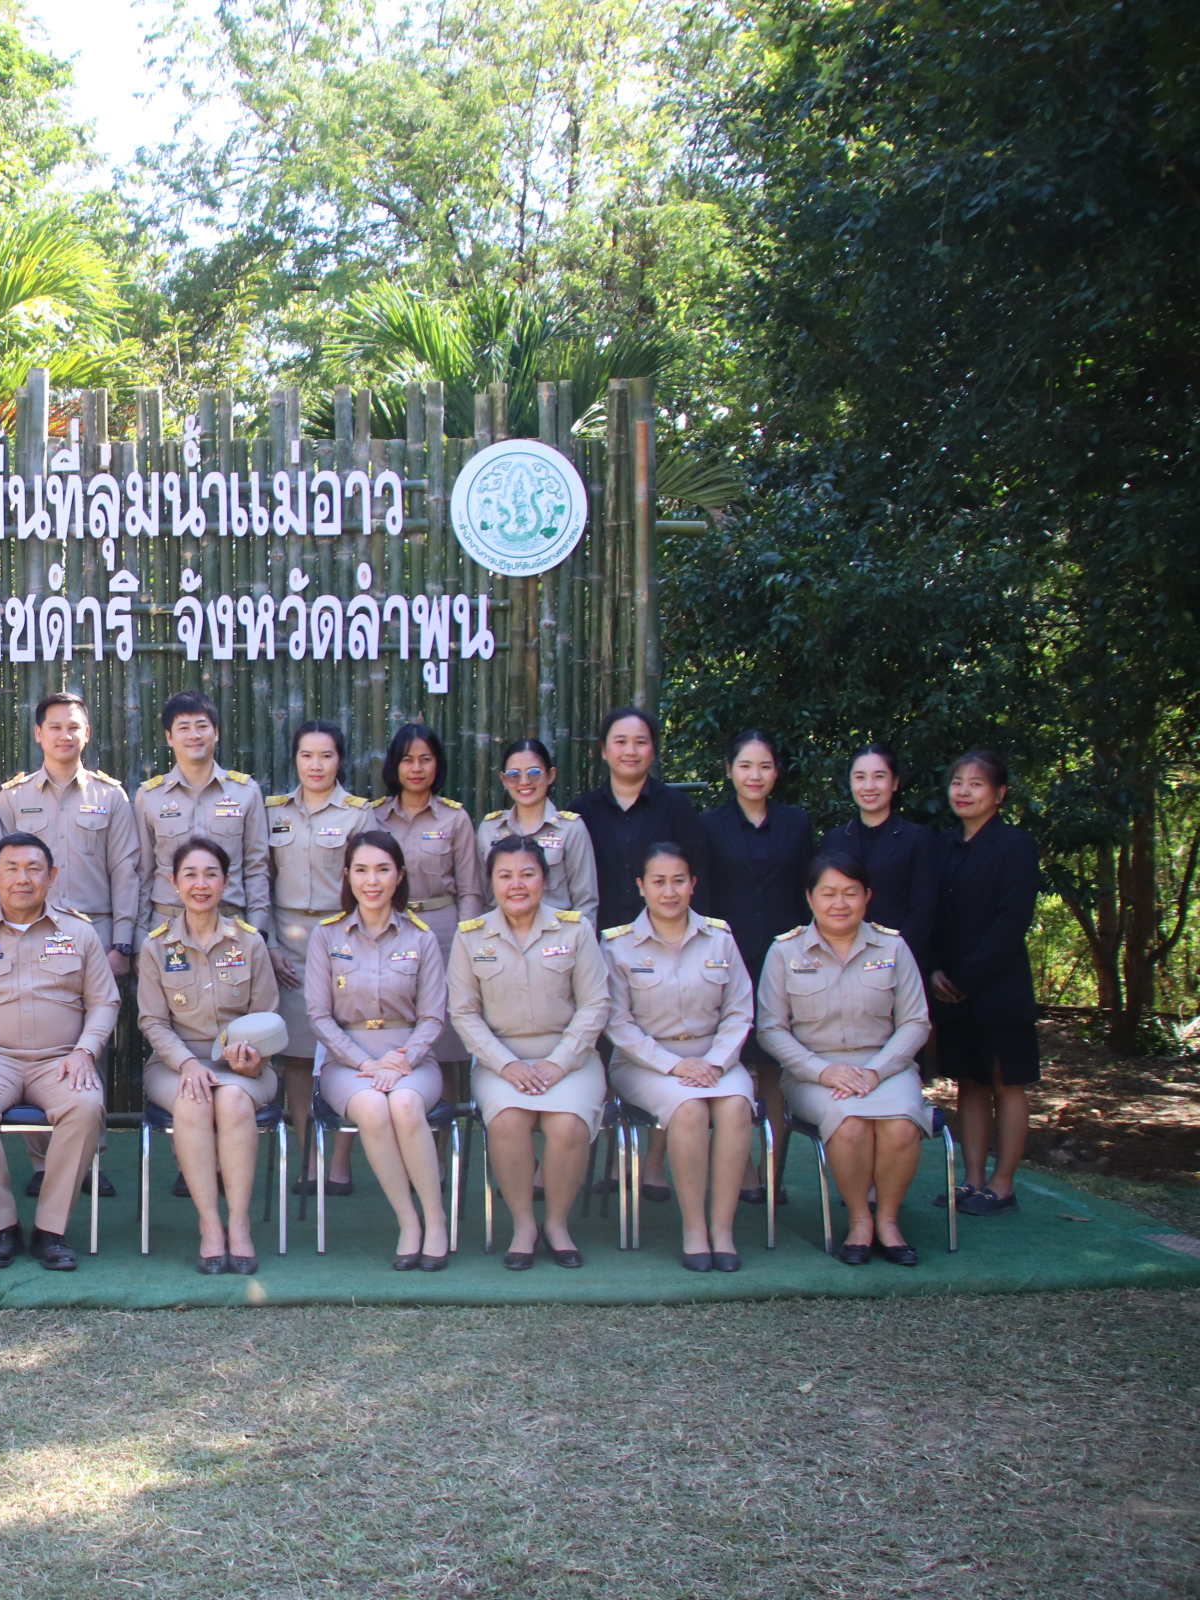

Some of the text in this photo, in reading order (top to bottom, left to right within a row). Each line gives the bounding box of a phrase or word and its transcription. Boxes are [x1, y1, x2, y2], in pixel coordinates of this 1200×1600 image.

[172, 561, 496, 694] จังหวัดลำพูน
